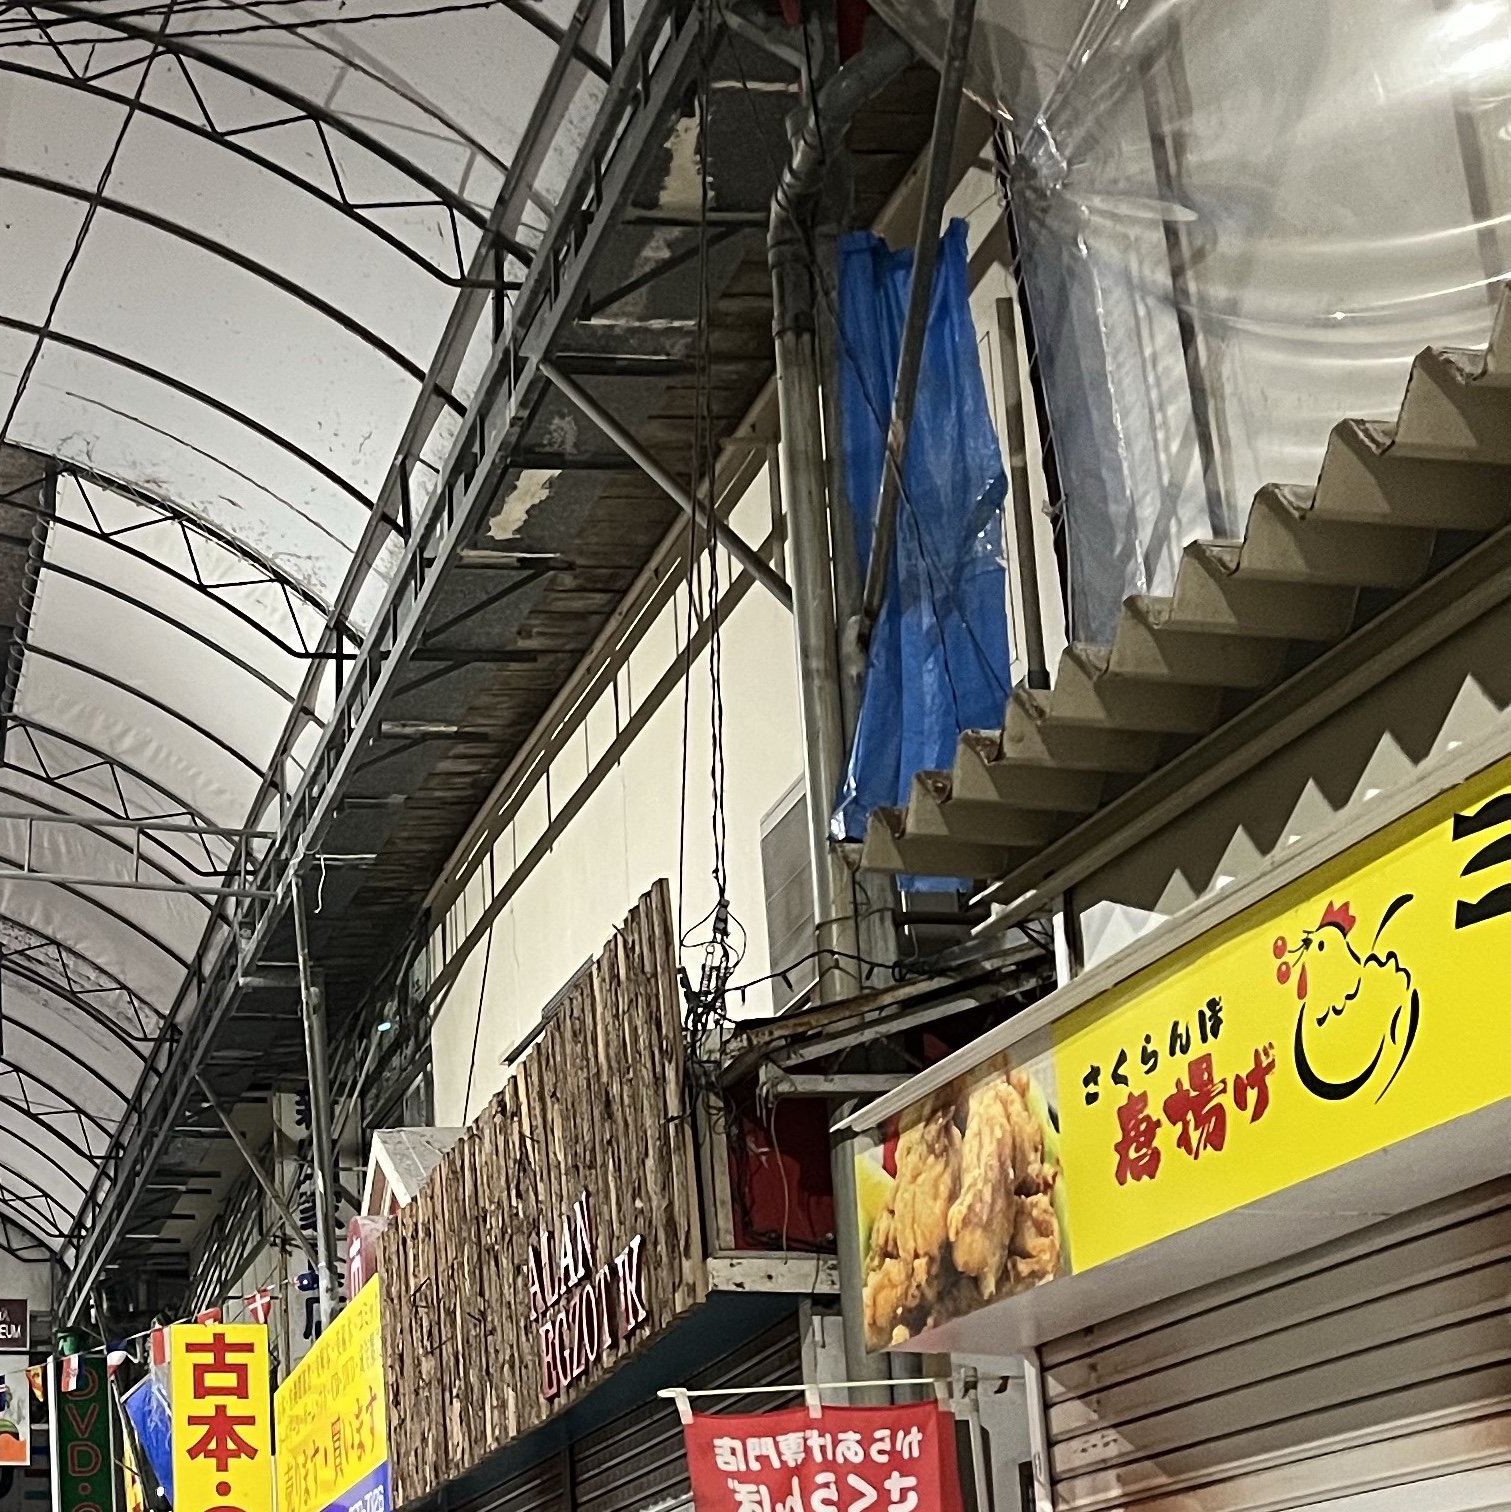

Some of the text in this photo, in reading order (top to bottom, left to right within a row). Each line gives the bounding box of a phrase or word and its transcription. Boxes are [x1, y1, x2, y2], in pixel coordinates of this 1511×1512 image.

[1082, 995, 1224, 1106] さくらんぼ
[1114, 1041, 1277, 1187] 唐揚げ
[528, 1190, 595, 1322] ALAN
